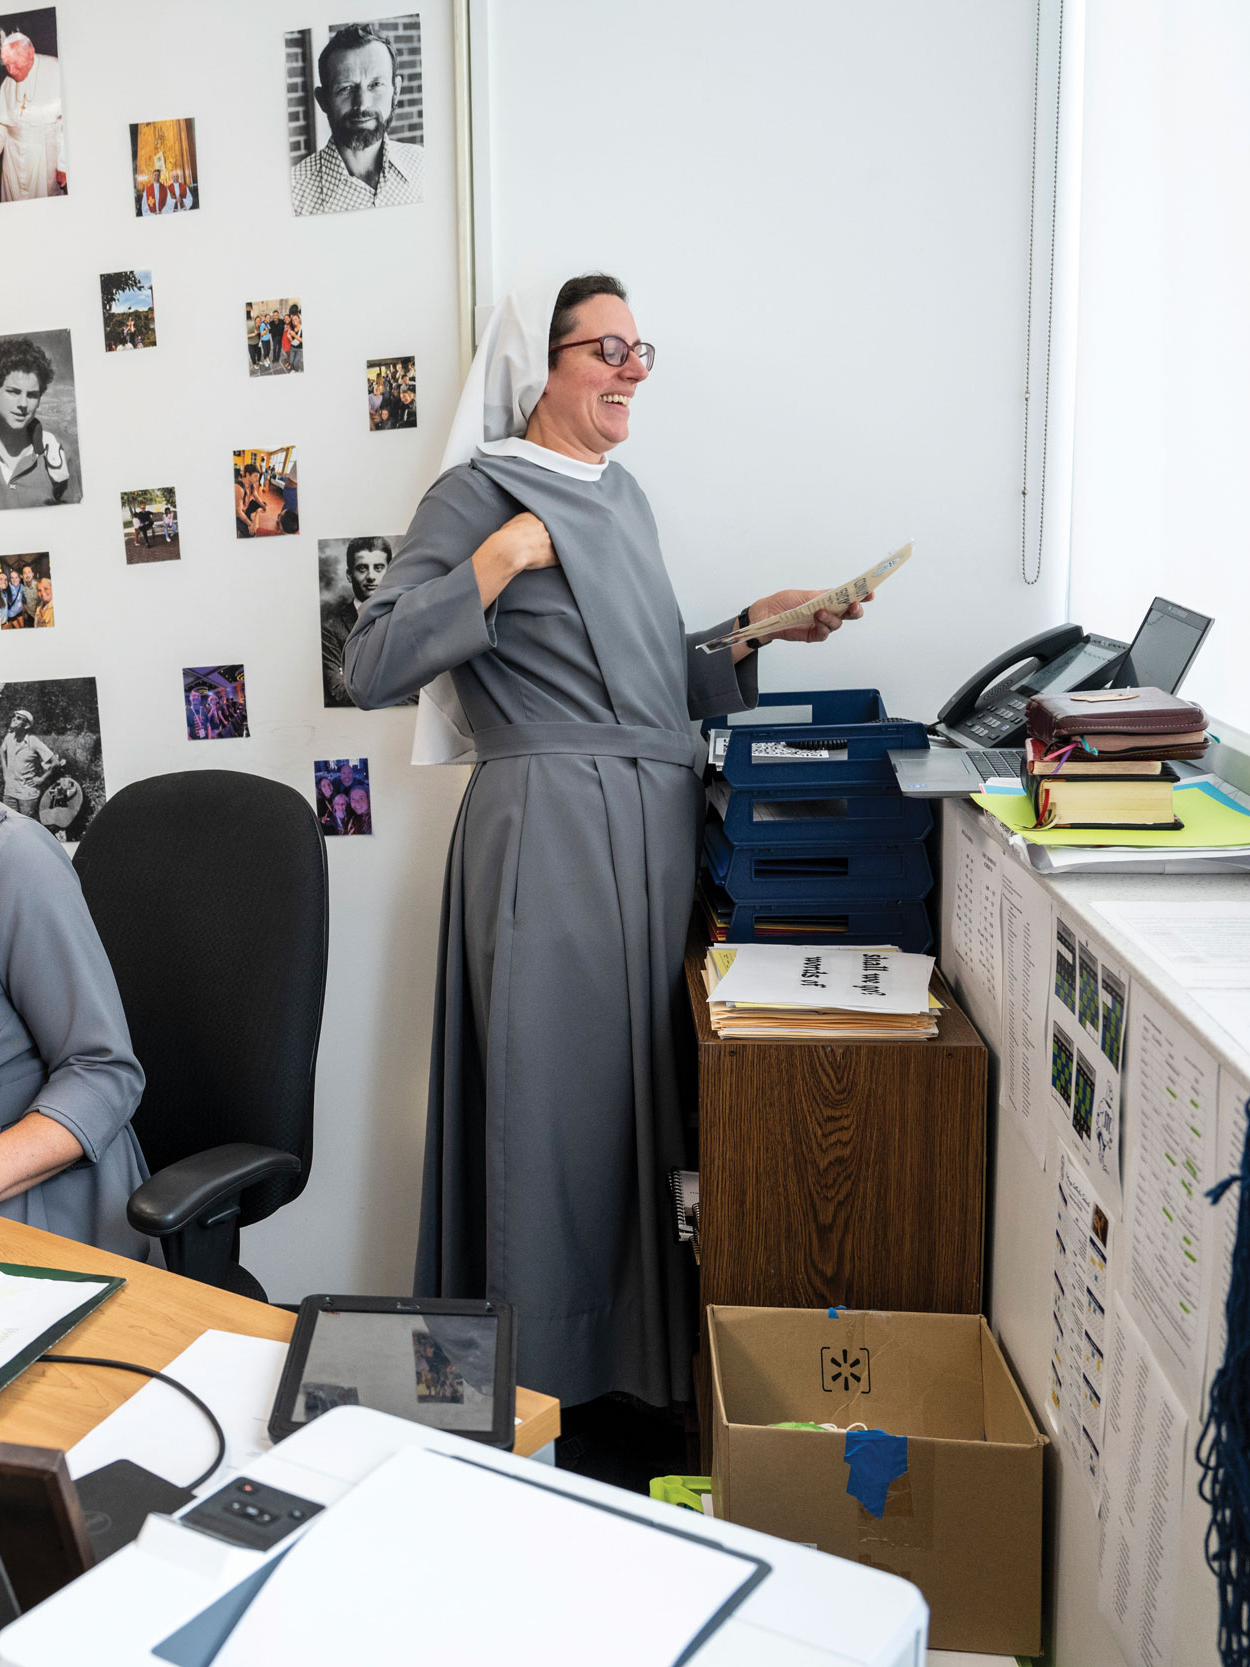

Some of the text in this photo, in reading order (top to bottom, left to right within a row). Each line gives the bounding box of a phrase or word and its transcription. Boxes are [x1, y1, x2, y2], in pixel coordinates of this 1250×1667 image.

[863, 954, 889, 971] shall
[800, 956, 828, 988] words of
[861, 973, 880, 984] we
